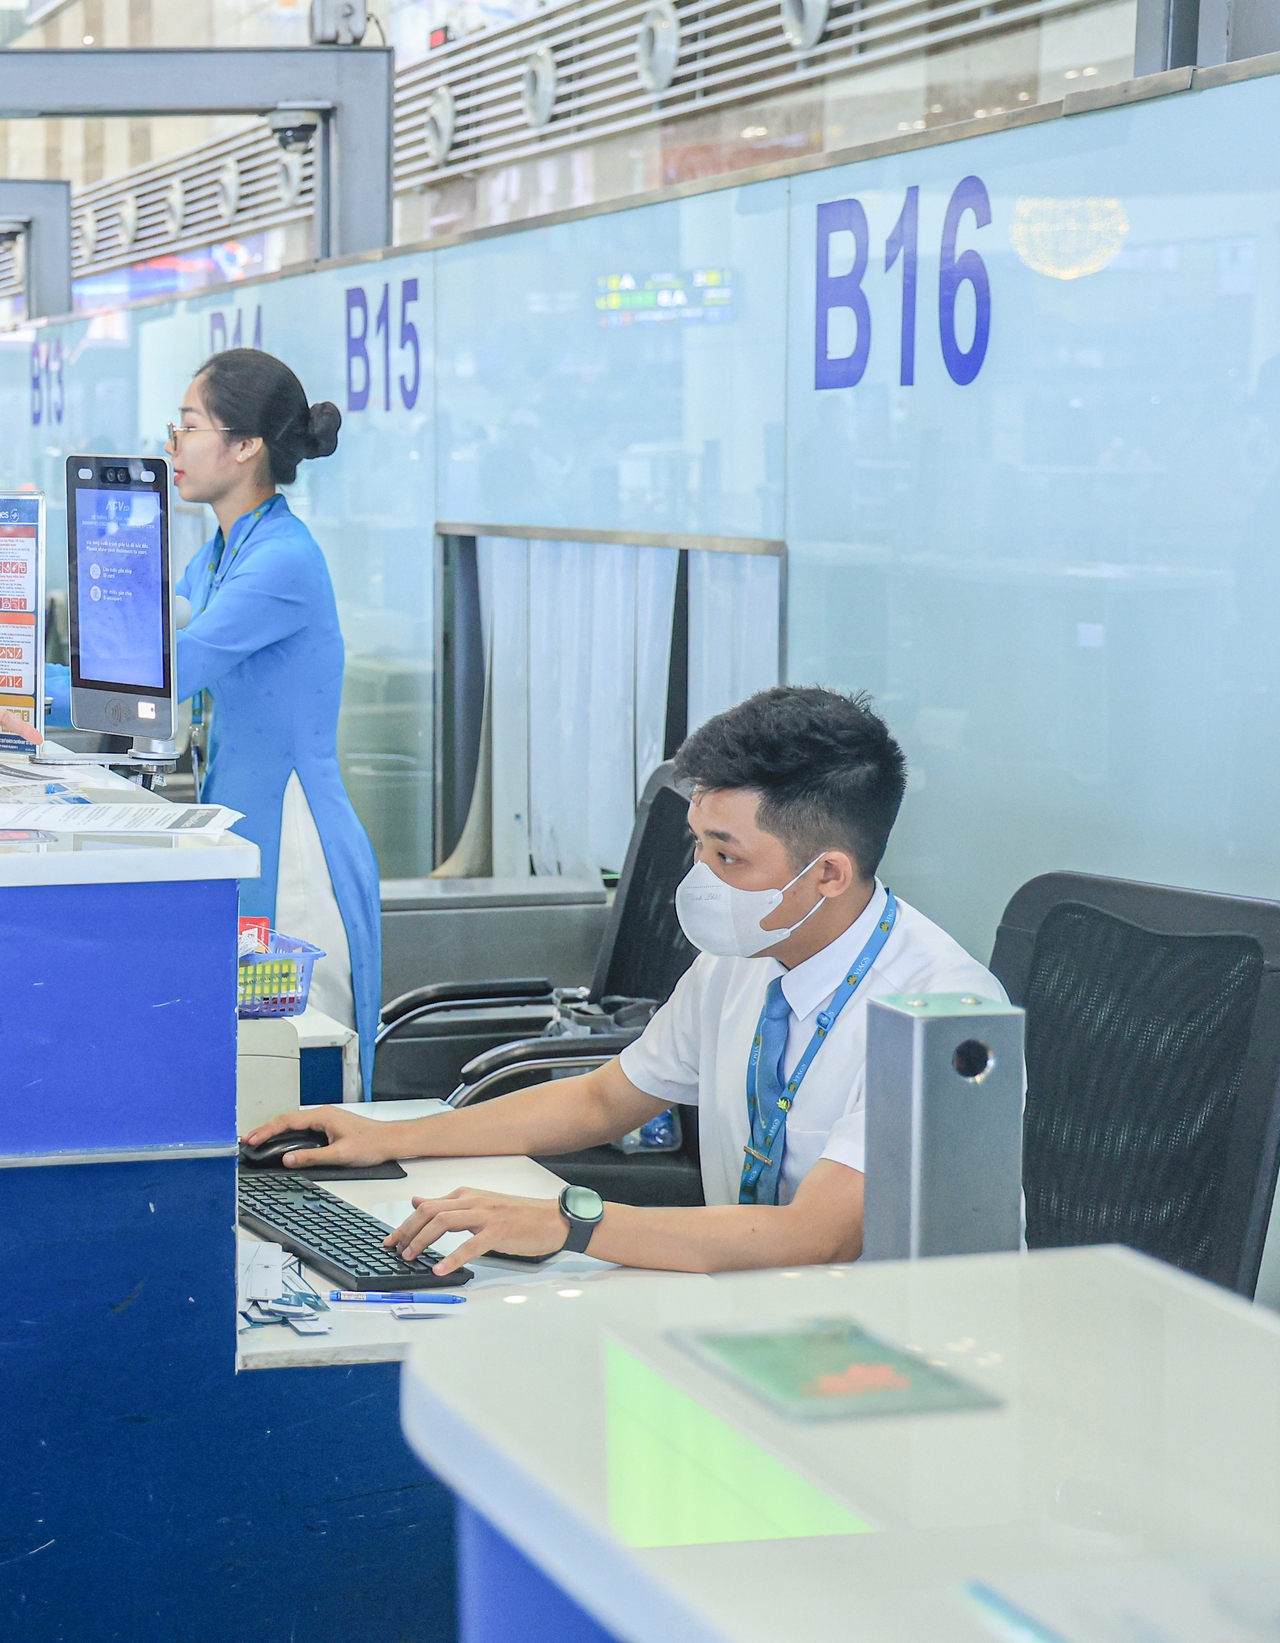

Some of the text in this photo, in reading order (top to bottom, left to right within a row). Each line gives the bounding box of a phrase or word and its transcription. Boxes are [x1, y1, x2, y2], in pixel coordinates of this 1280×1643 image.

[814, 175, 992, 390] B16
[346, 278, 420, 412] B15
[853, 956, 869, 975] VIAGS
[793, 1062, 806, 1082] VIAGS
